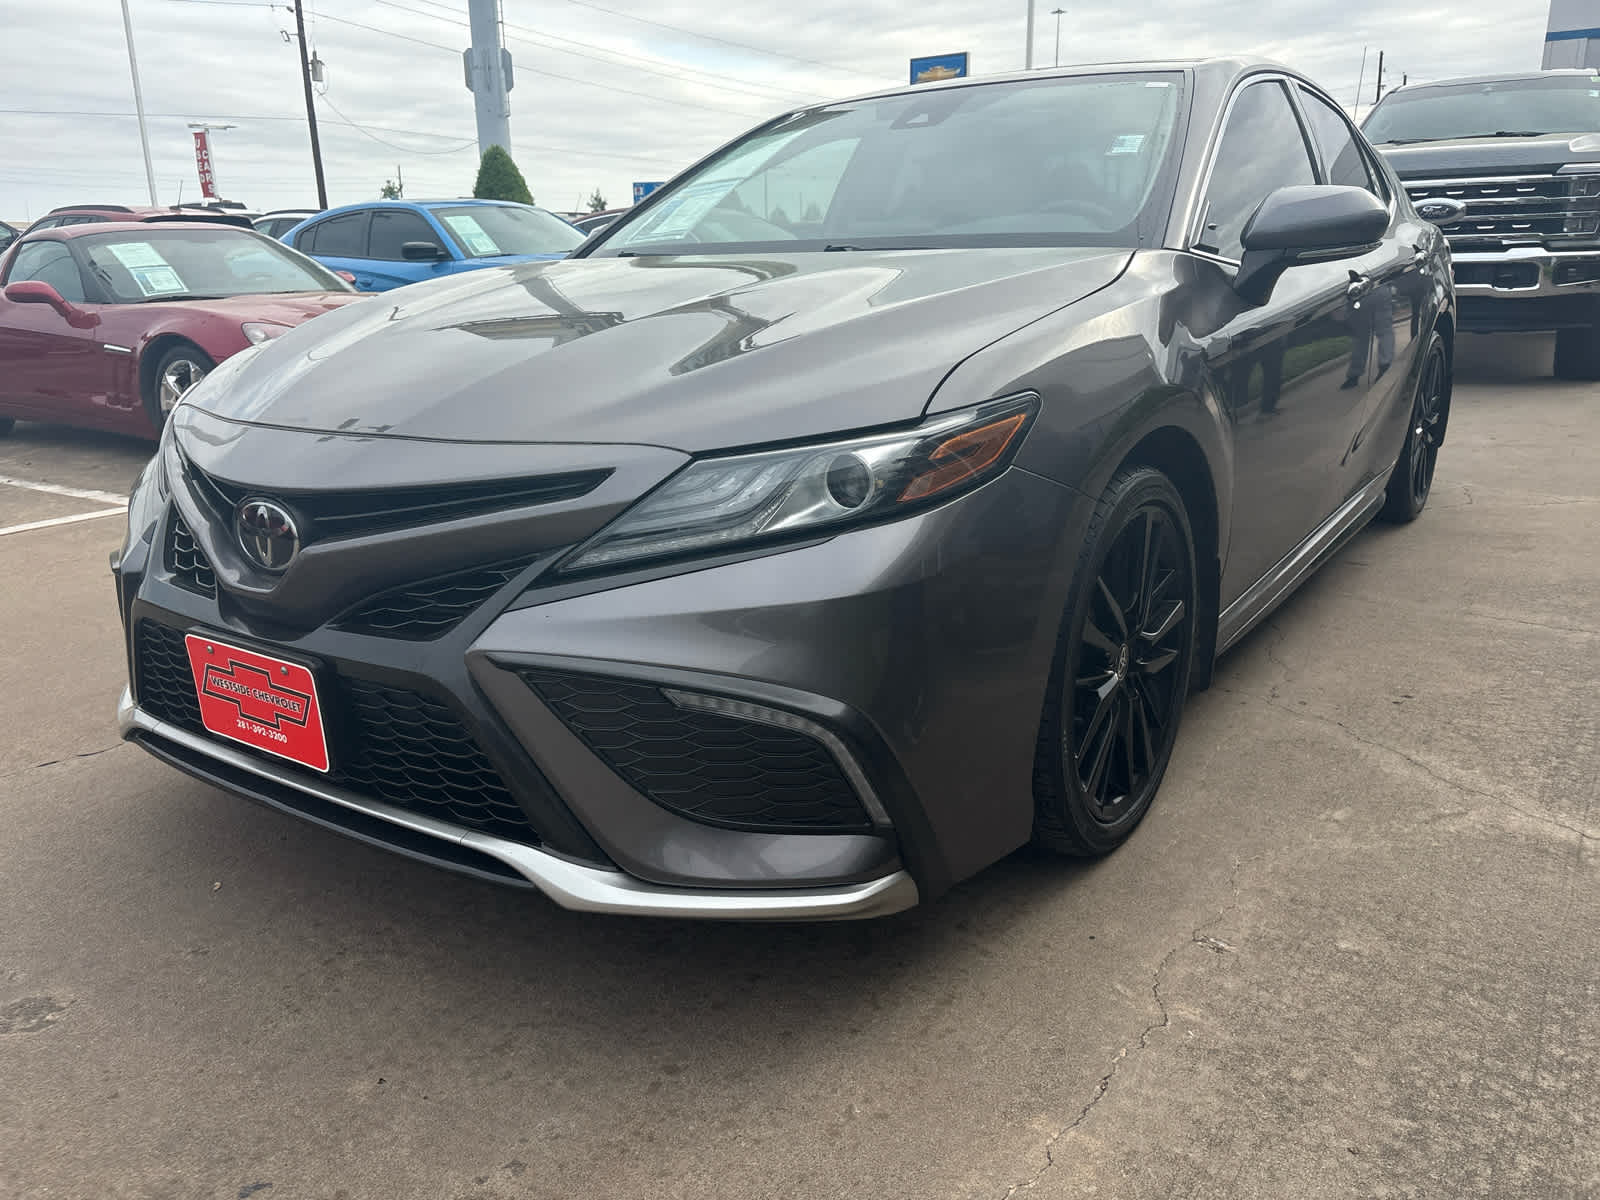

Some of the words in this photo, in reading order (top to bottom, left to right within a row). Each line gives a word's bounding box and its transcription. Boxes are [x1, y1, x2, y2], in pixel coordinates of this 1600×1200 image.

[210, 674, 251, 696] WESTSIDE
[251, 687, 302, 713] CHEVROLET
[236, 719, 288, 744] 281-392-3200
